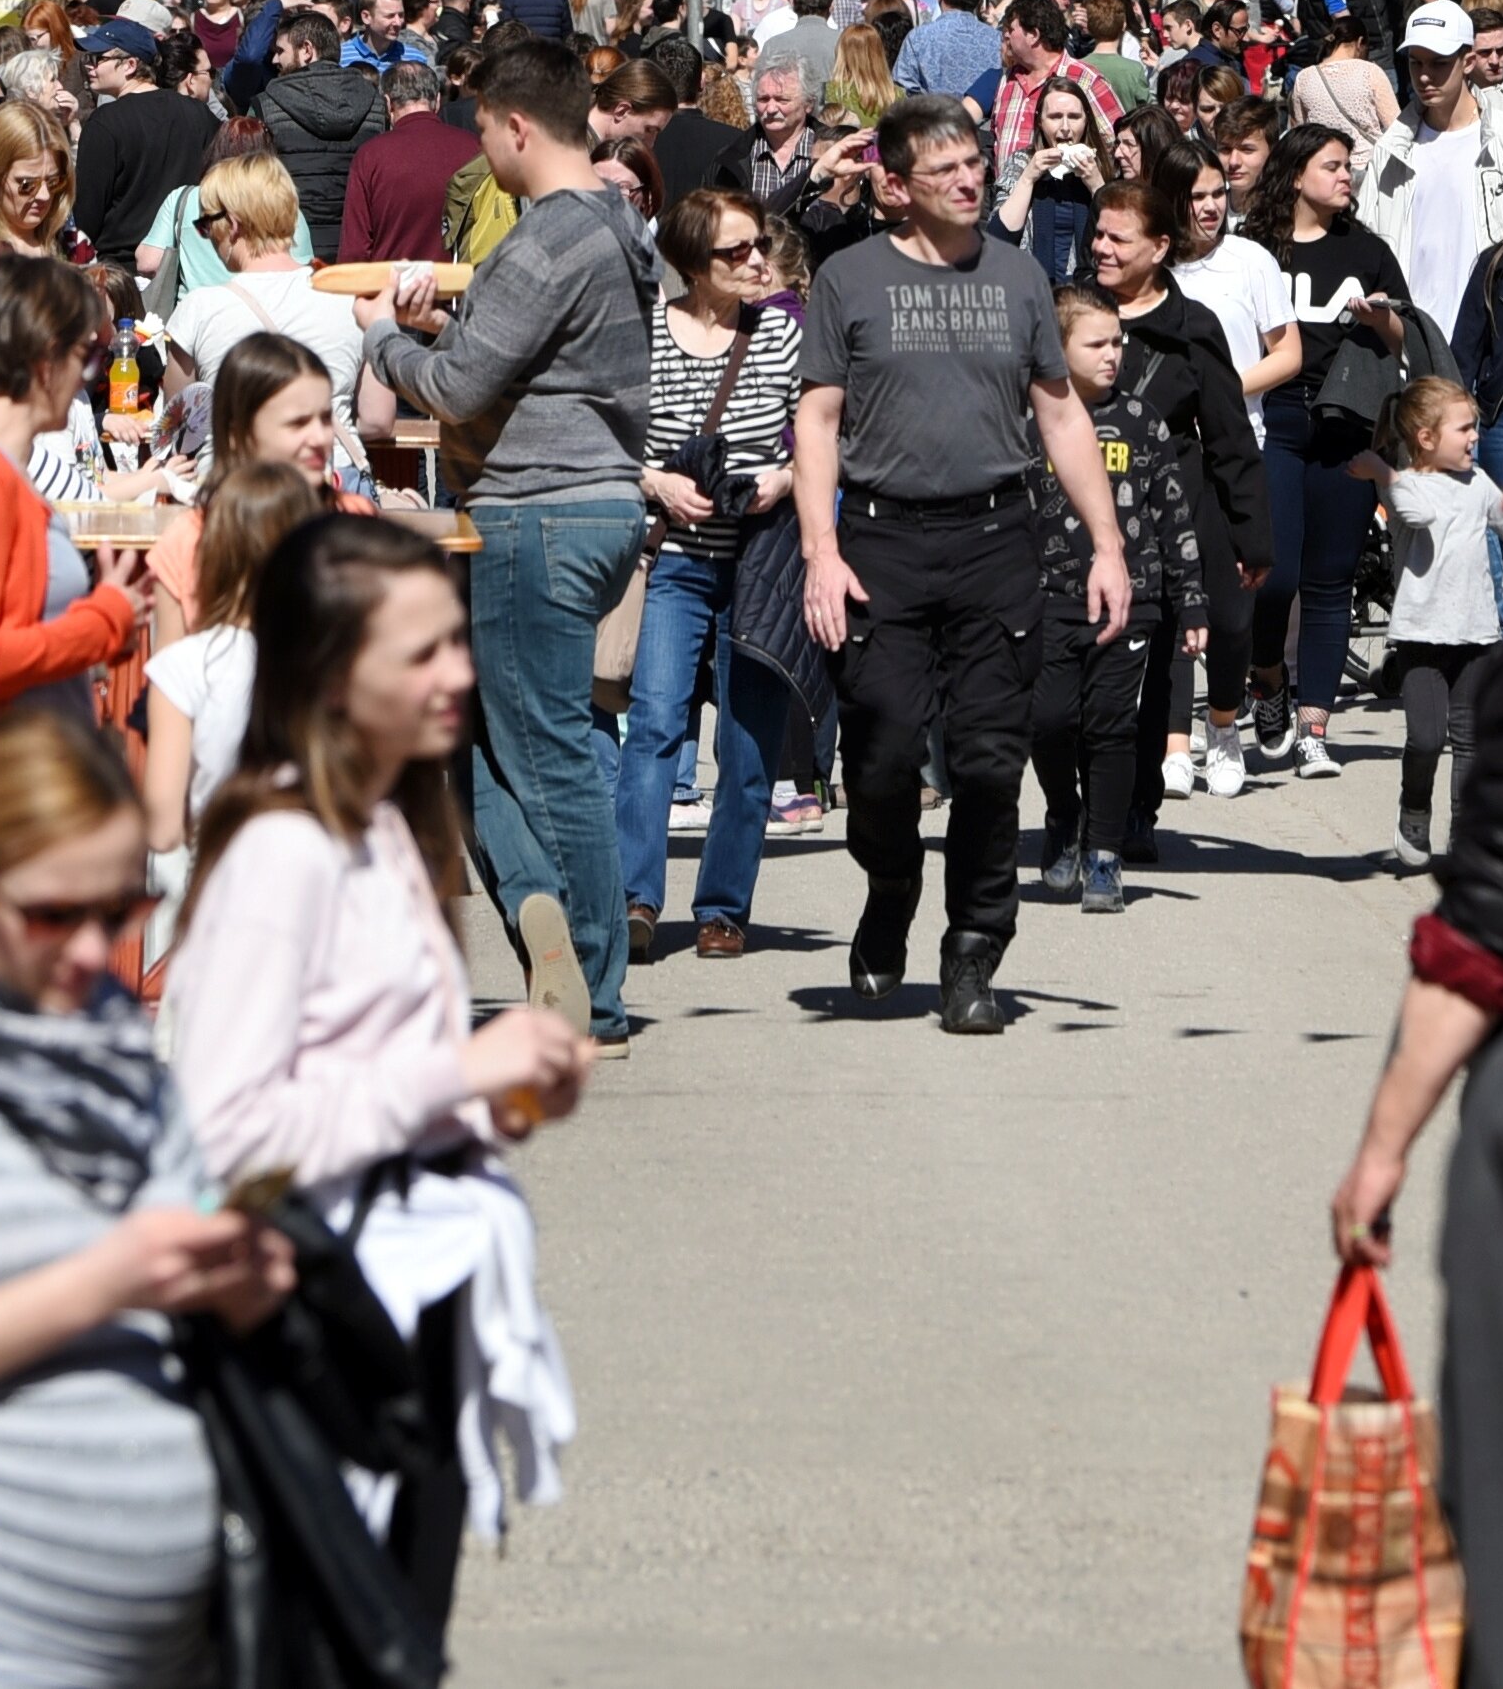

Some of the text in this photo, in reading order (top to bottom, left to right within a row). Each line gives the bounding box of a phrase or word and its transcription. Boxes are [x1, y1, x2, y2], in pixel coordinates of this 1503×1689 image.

[886, 283, 1006, 309] TOM TAILOR
[891, 310, 1009, 331] JEANS BRAND
